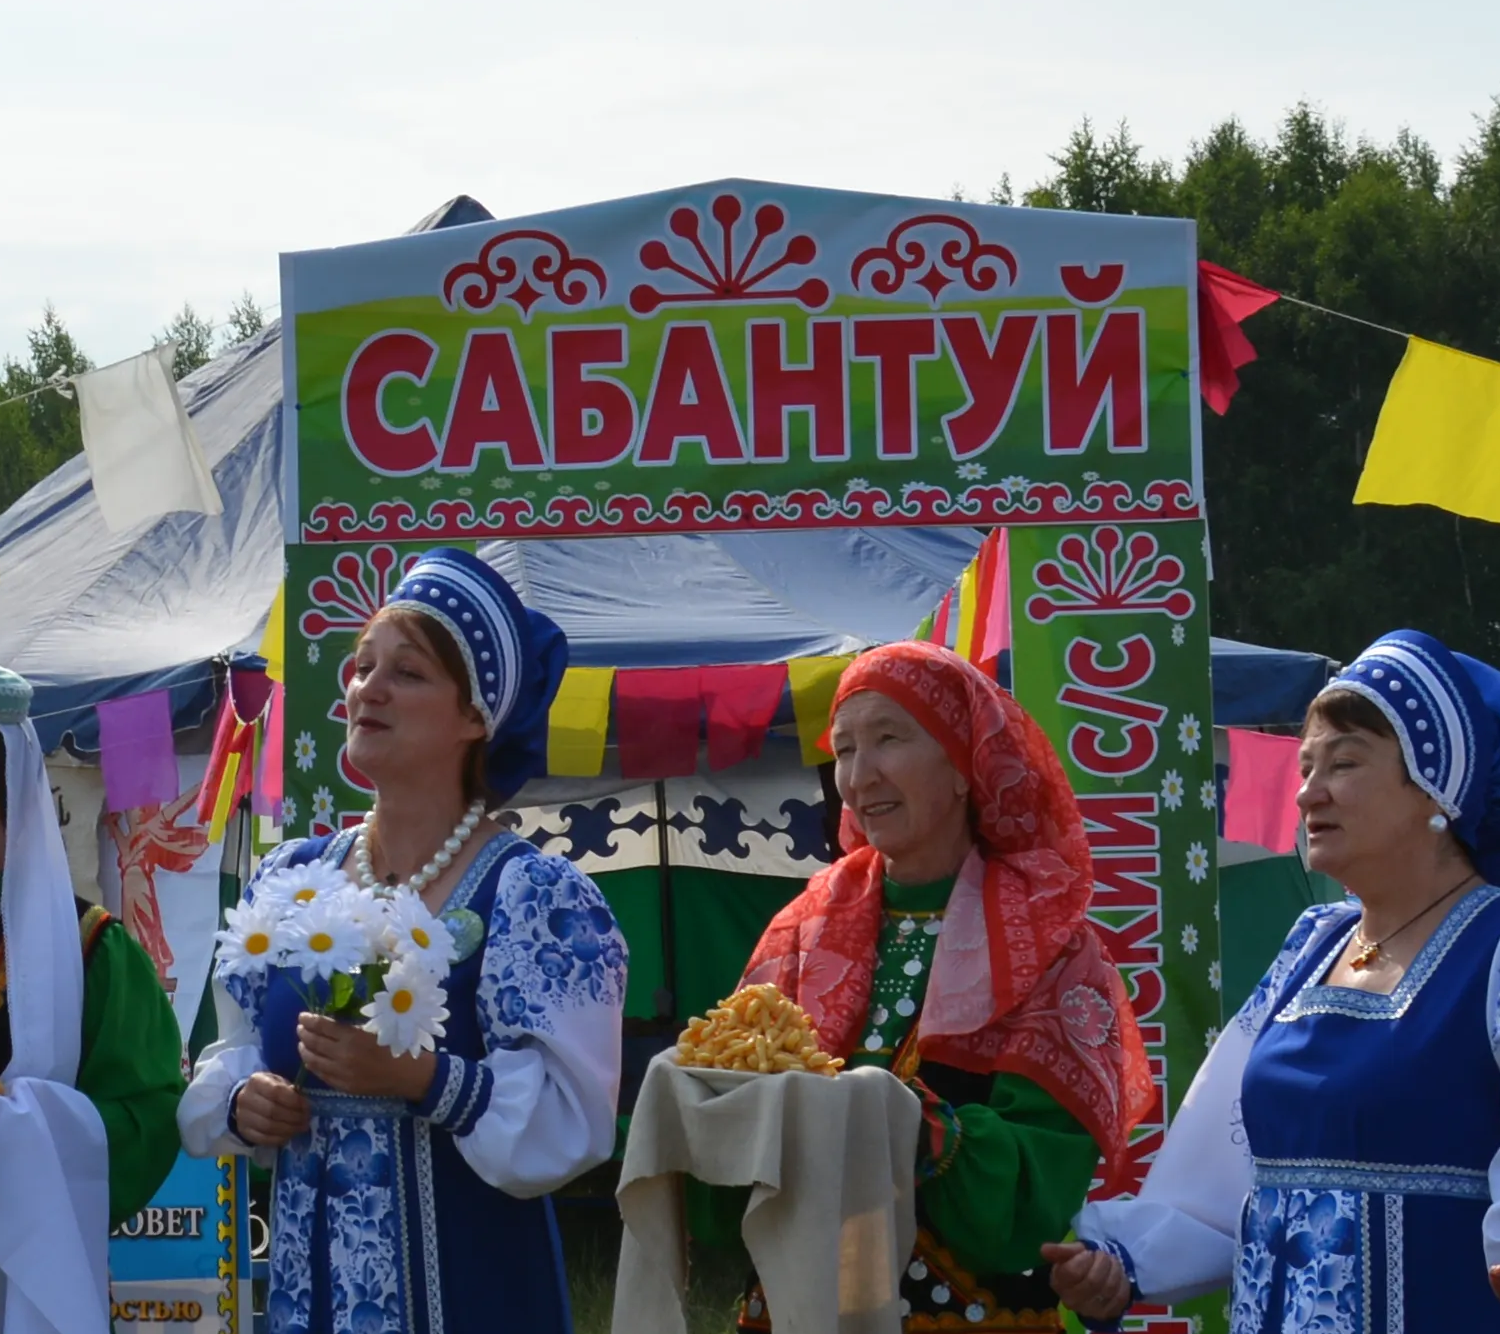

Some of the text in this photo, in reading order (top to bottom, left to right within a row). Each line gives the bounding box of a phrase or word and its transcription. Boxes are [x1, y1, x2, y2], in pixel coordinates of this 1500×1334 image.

[343, 261, 1148, 473] САБАНТУЙ
[1056, 633, 1168, 778] С/С
[111, 1207, 204, 1237] ОВЕТ
